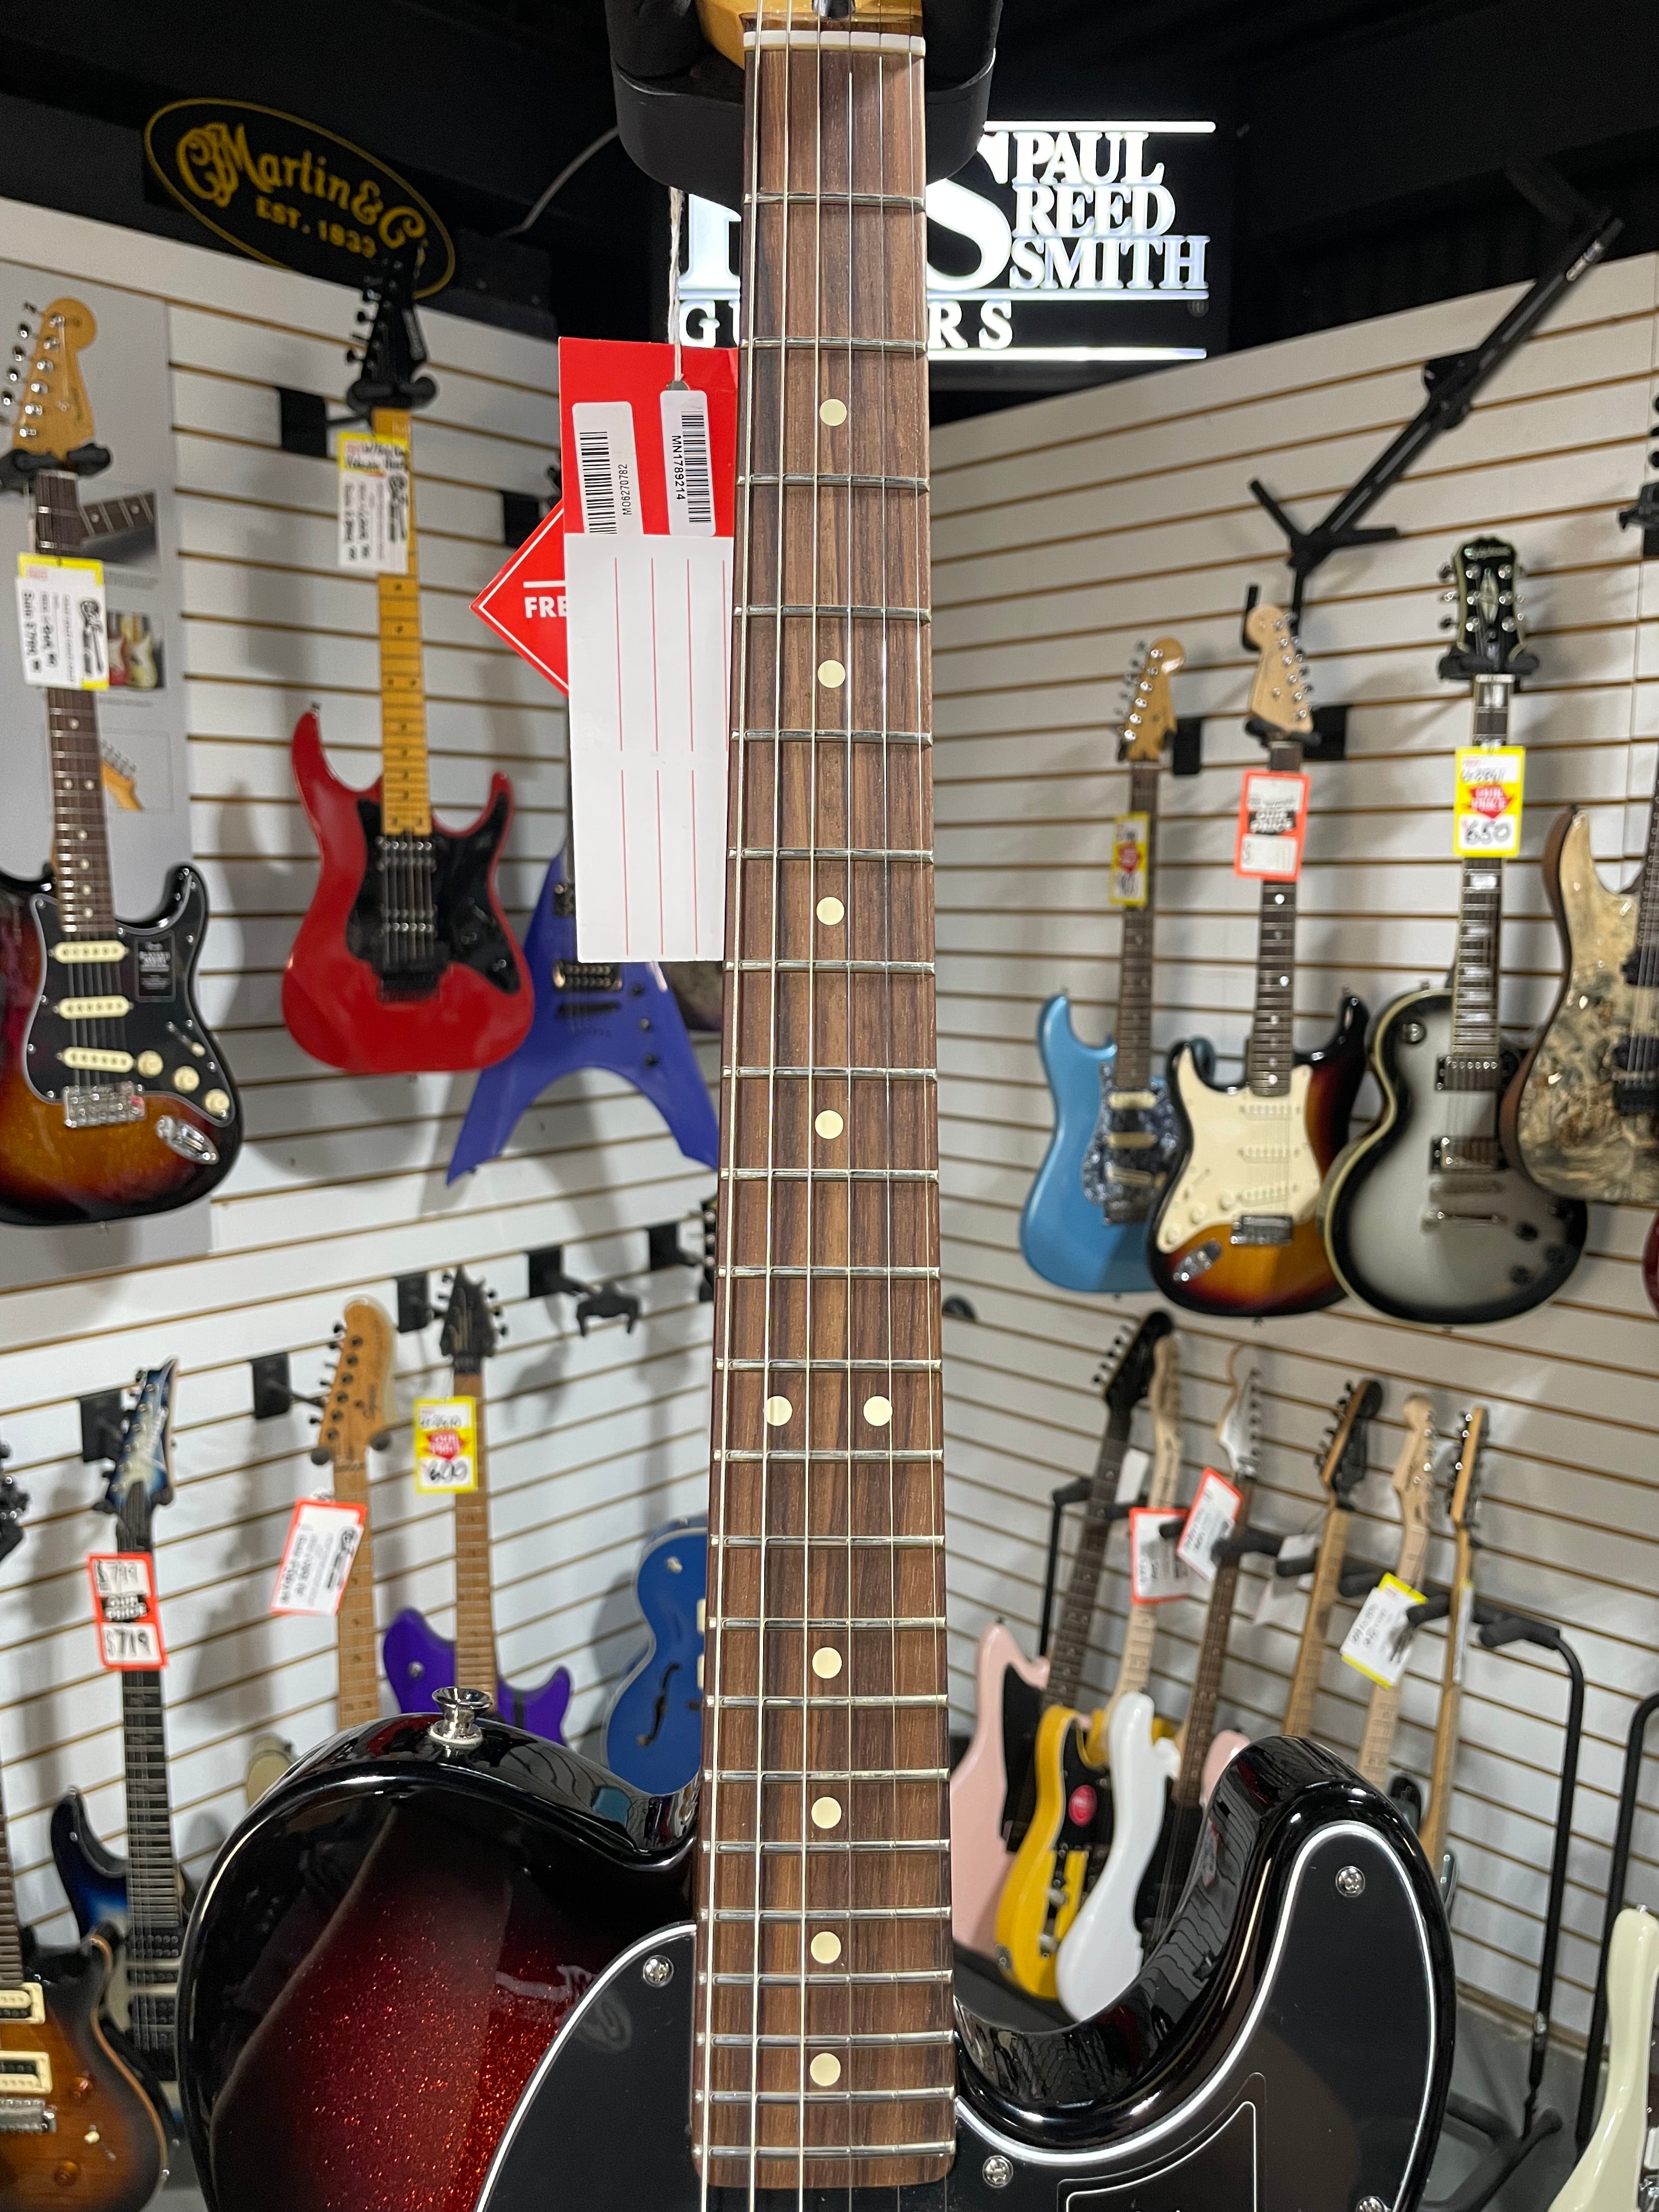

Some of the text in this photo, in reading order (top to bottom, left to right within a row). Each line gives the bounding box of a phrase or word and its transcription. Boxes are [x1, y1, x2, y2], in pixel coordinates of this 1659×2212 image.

[1012, 131, 1165, 185] PAUL
[1012, 184, 1176, 238] REED
[1009, 236, 1210, 290] SMITH
[672, 435, 686, 500] MN1789214
